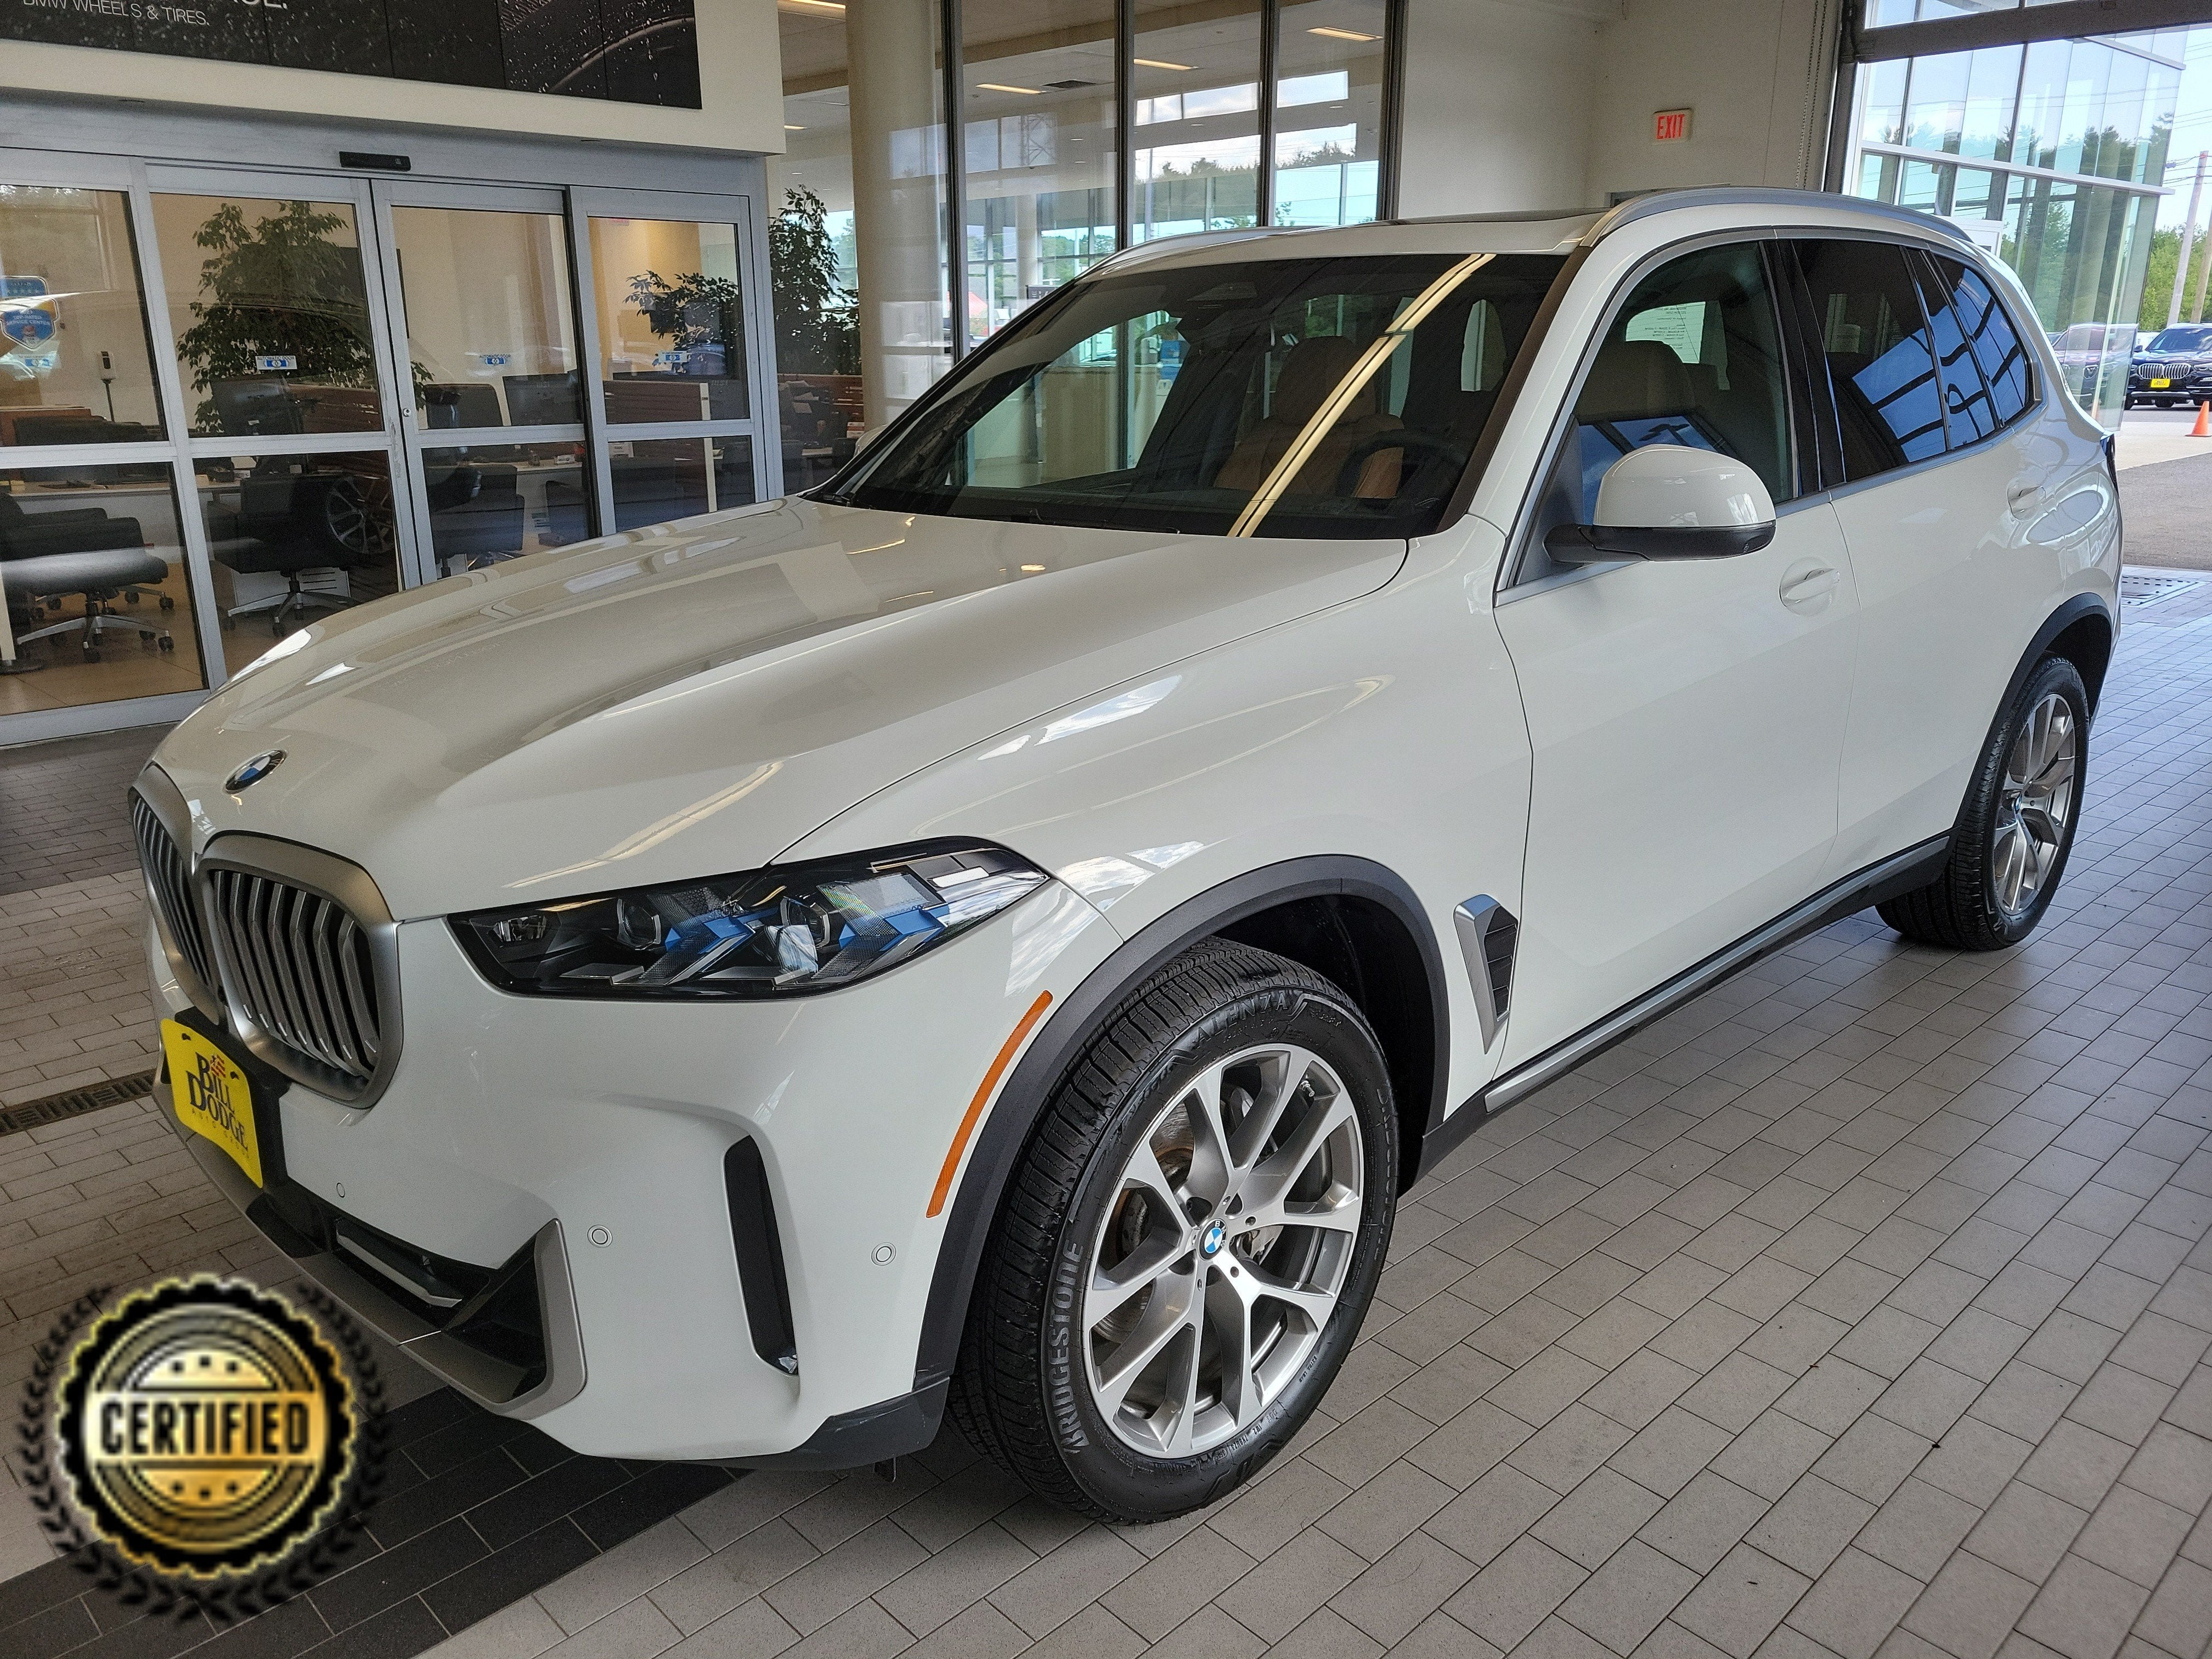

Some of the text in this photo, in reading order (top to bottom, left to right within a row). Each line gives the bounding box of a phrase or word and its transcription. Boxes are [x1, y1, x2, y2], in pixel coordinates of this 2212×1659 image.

[72, 0, 142, 18] WHEELS
[147, 5, 160, 20] &
[161, 6, 211, 26] TIRES.
[1657, 114, 1685, 139] EXIT
[185, 1070, 249, 1153] DODGE
[195, 1051, 235, 1114] BILL
[1048, 1238, 1090, 1454] BRIDGESTONE
